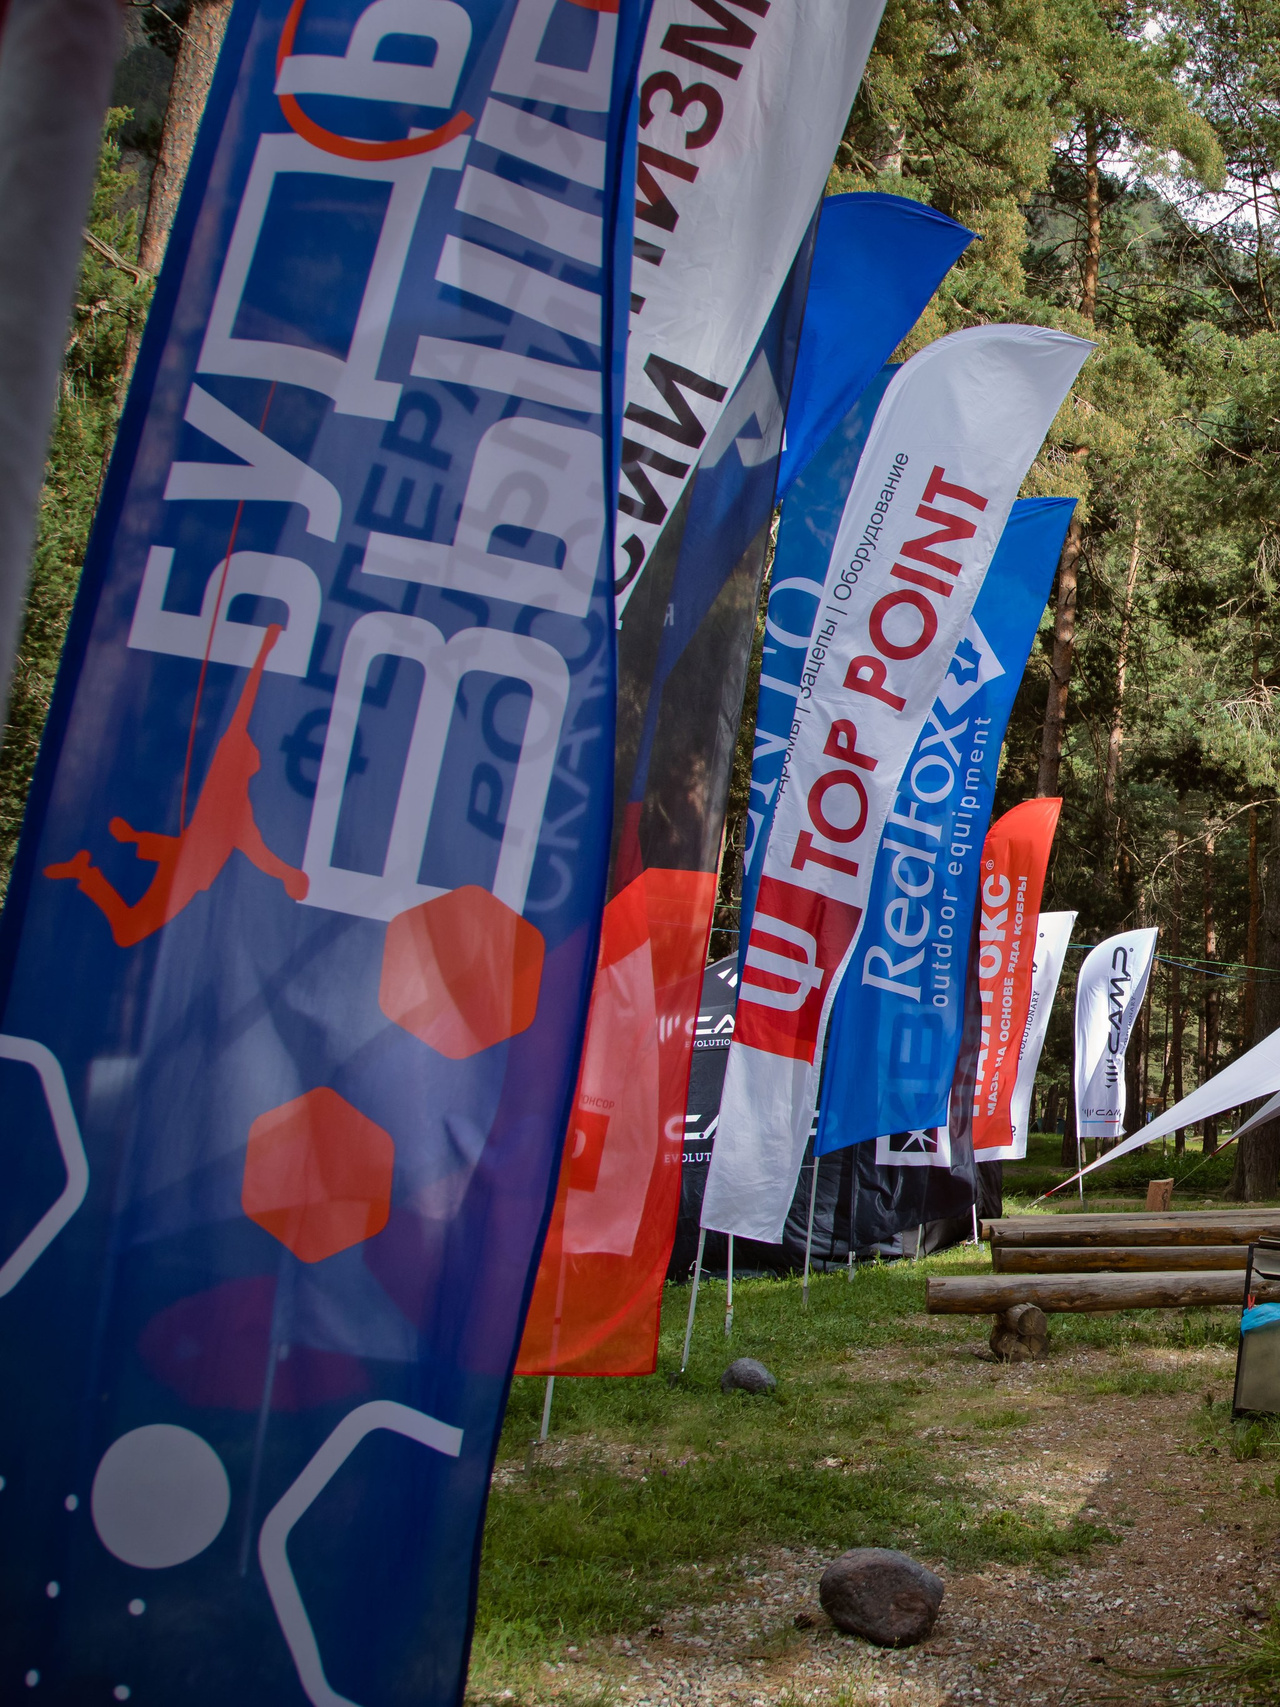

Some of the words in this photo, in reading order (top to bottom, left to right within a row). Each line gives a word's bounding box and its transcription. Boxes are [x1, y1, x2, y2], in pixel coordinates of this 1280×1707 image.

[126, 0, 473, 678] БУДЬ
[799, 617, 838, 700] Зацепы
[833, 451, 909, 602] Оборудование
[791, 717, 879, 877] TOP
[843, 464, 990, 712] POINT
[861, 706, 970, 1003] RedFox
[932, 888, 957, 1008] outdoor
[948, 716, 992, 876] equipment
[1013, 876, 1028, 935] КОБРЫ
[999, 977, 1014, 1042] ОСНОВЕ
[1007, 940, 1021, 974] ЯДА
[1108, 946, 1131, 1055] CAMP
[987, 1071, 999, 1116] МАЗЬ
[995, 1046, 1007, 1068] НА
